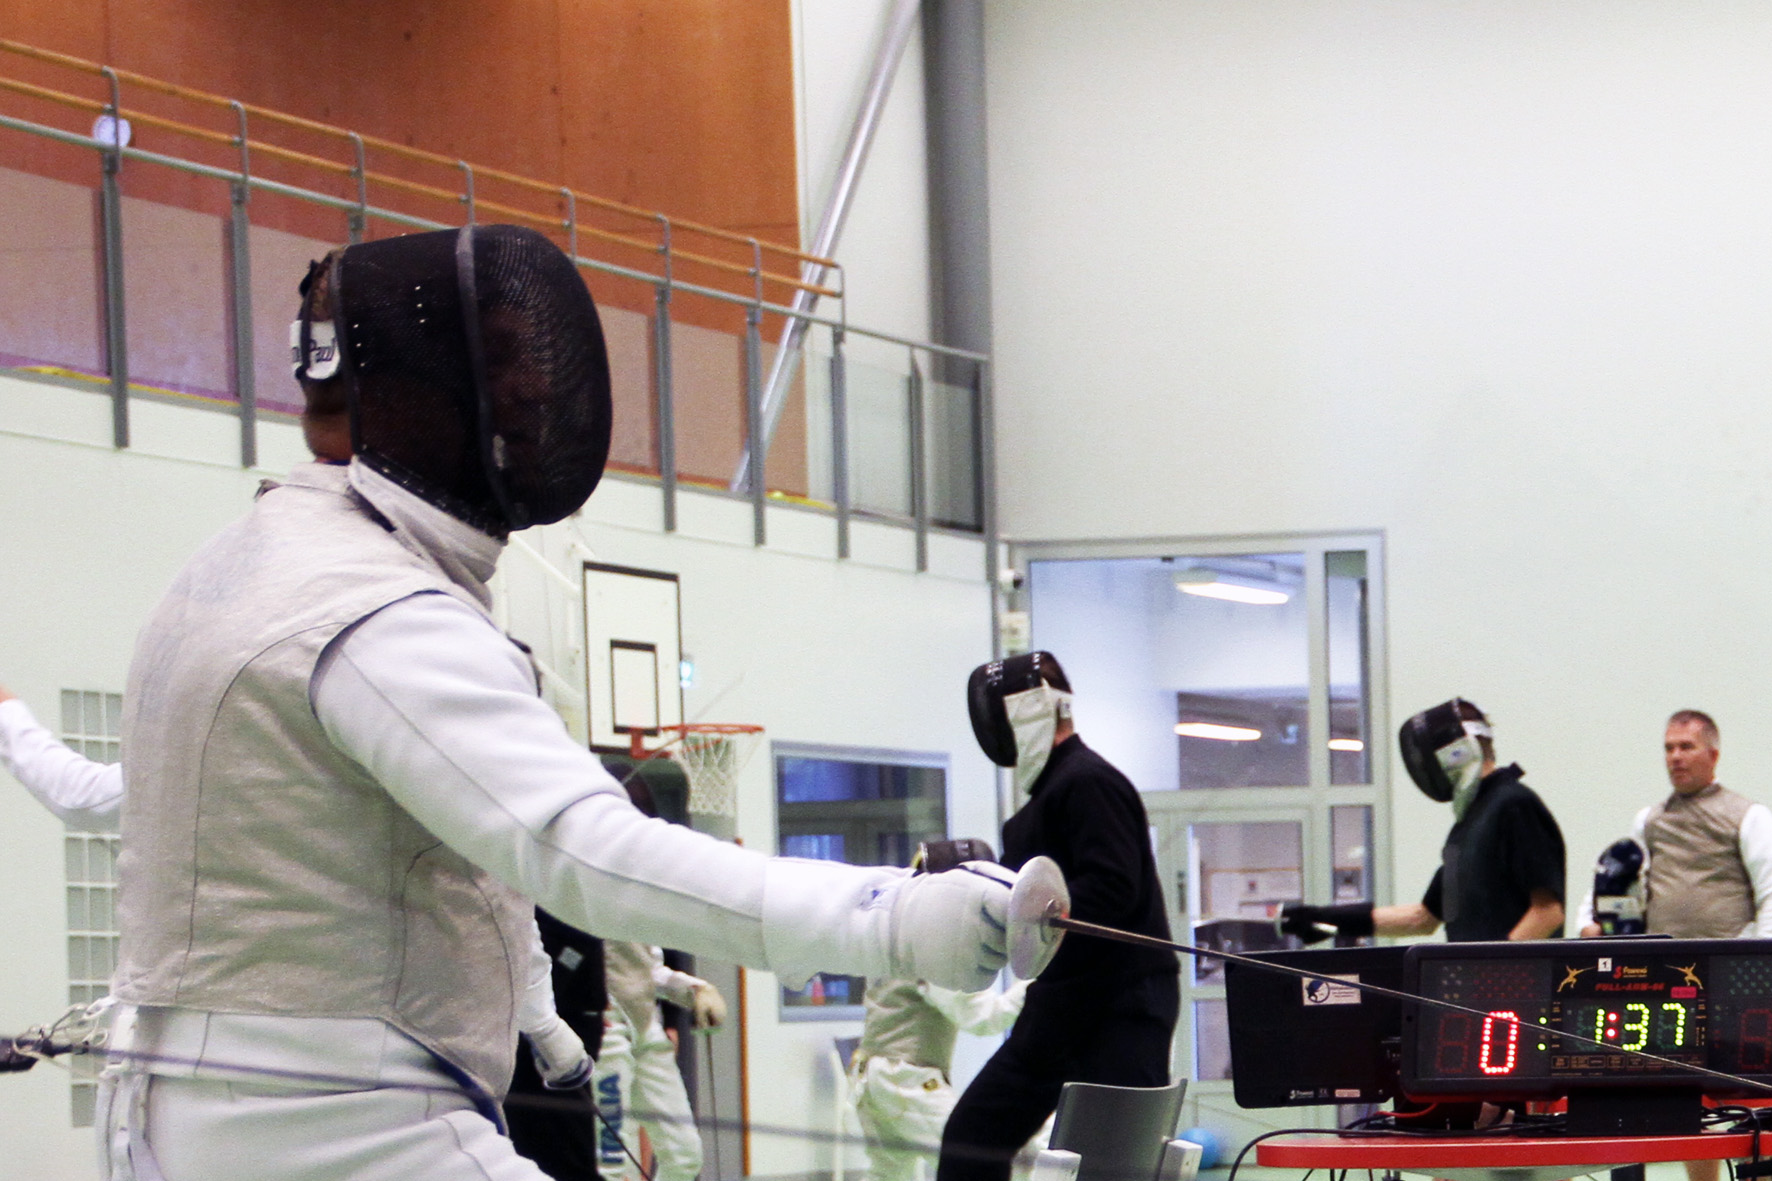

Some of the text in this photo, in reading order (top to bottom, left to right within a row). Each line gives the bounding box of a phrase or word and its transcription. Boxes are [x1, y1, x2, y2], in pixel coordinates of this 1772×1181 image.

[1479, 1010, 1520, 1076] 0
[1595, 1002, 1688, 1052] 1:37
[598, 1073, 624, 1166] ITALIA
